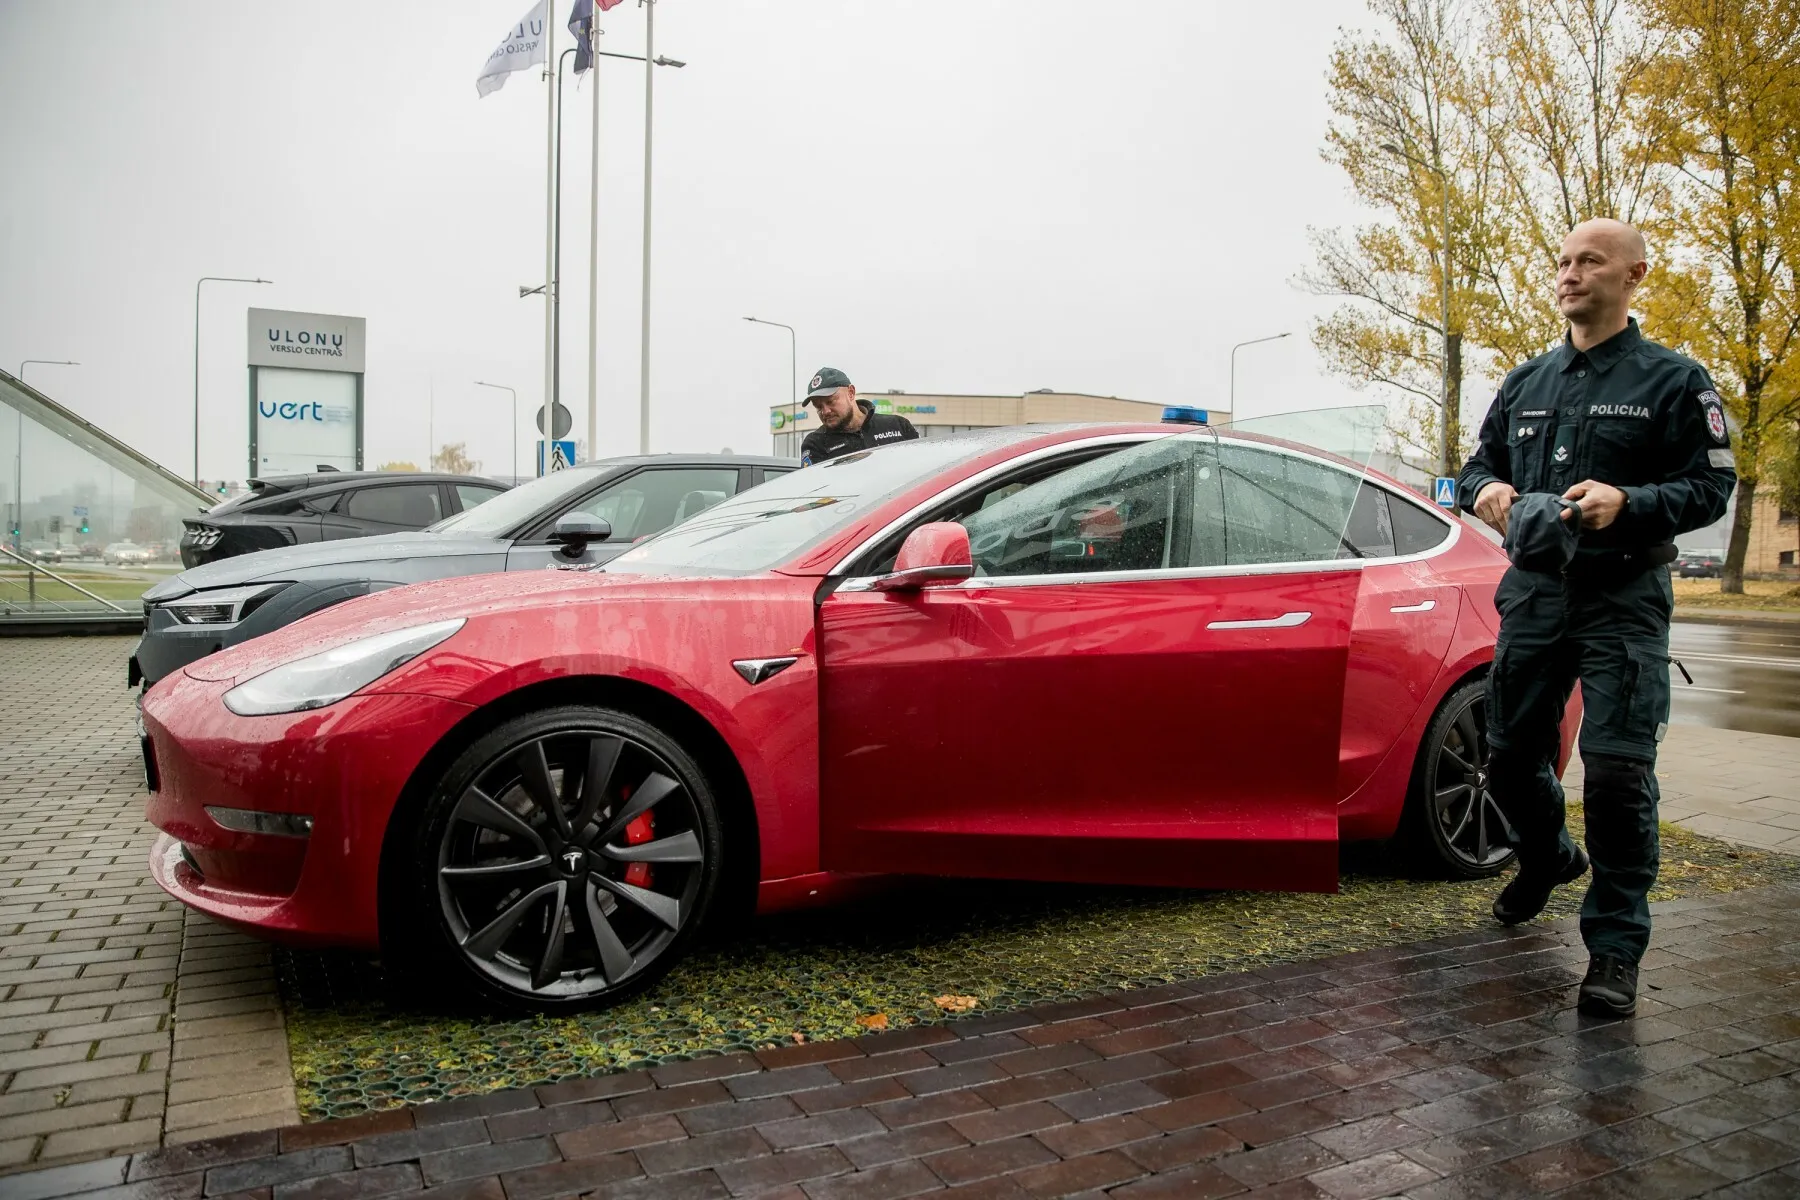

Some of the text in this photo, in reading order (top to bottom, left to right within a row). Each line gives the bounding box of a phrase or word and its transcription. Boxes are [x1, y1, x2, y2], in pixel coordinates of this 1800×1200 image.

[269, 328, 343, 350] ULONŲ
[269, 344, 343, 357] VERSLO CENTRAS
[259, 401, 323, 421] vert
[1589, 404, 1650, 418] POLICIJA
[874, 430, 902, 441] POLICIJA
